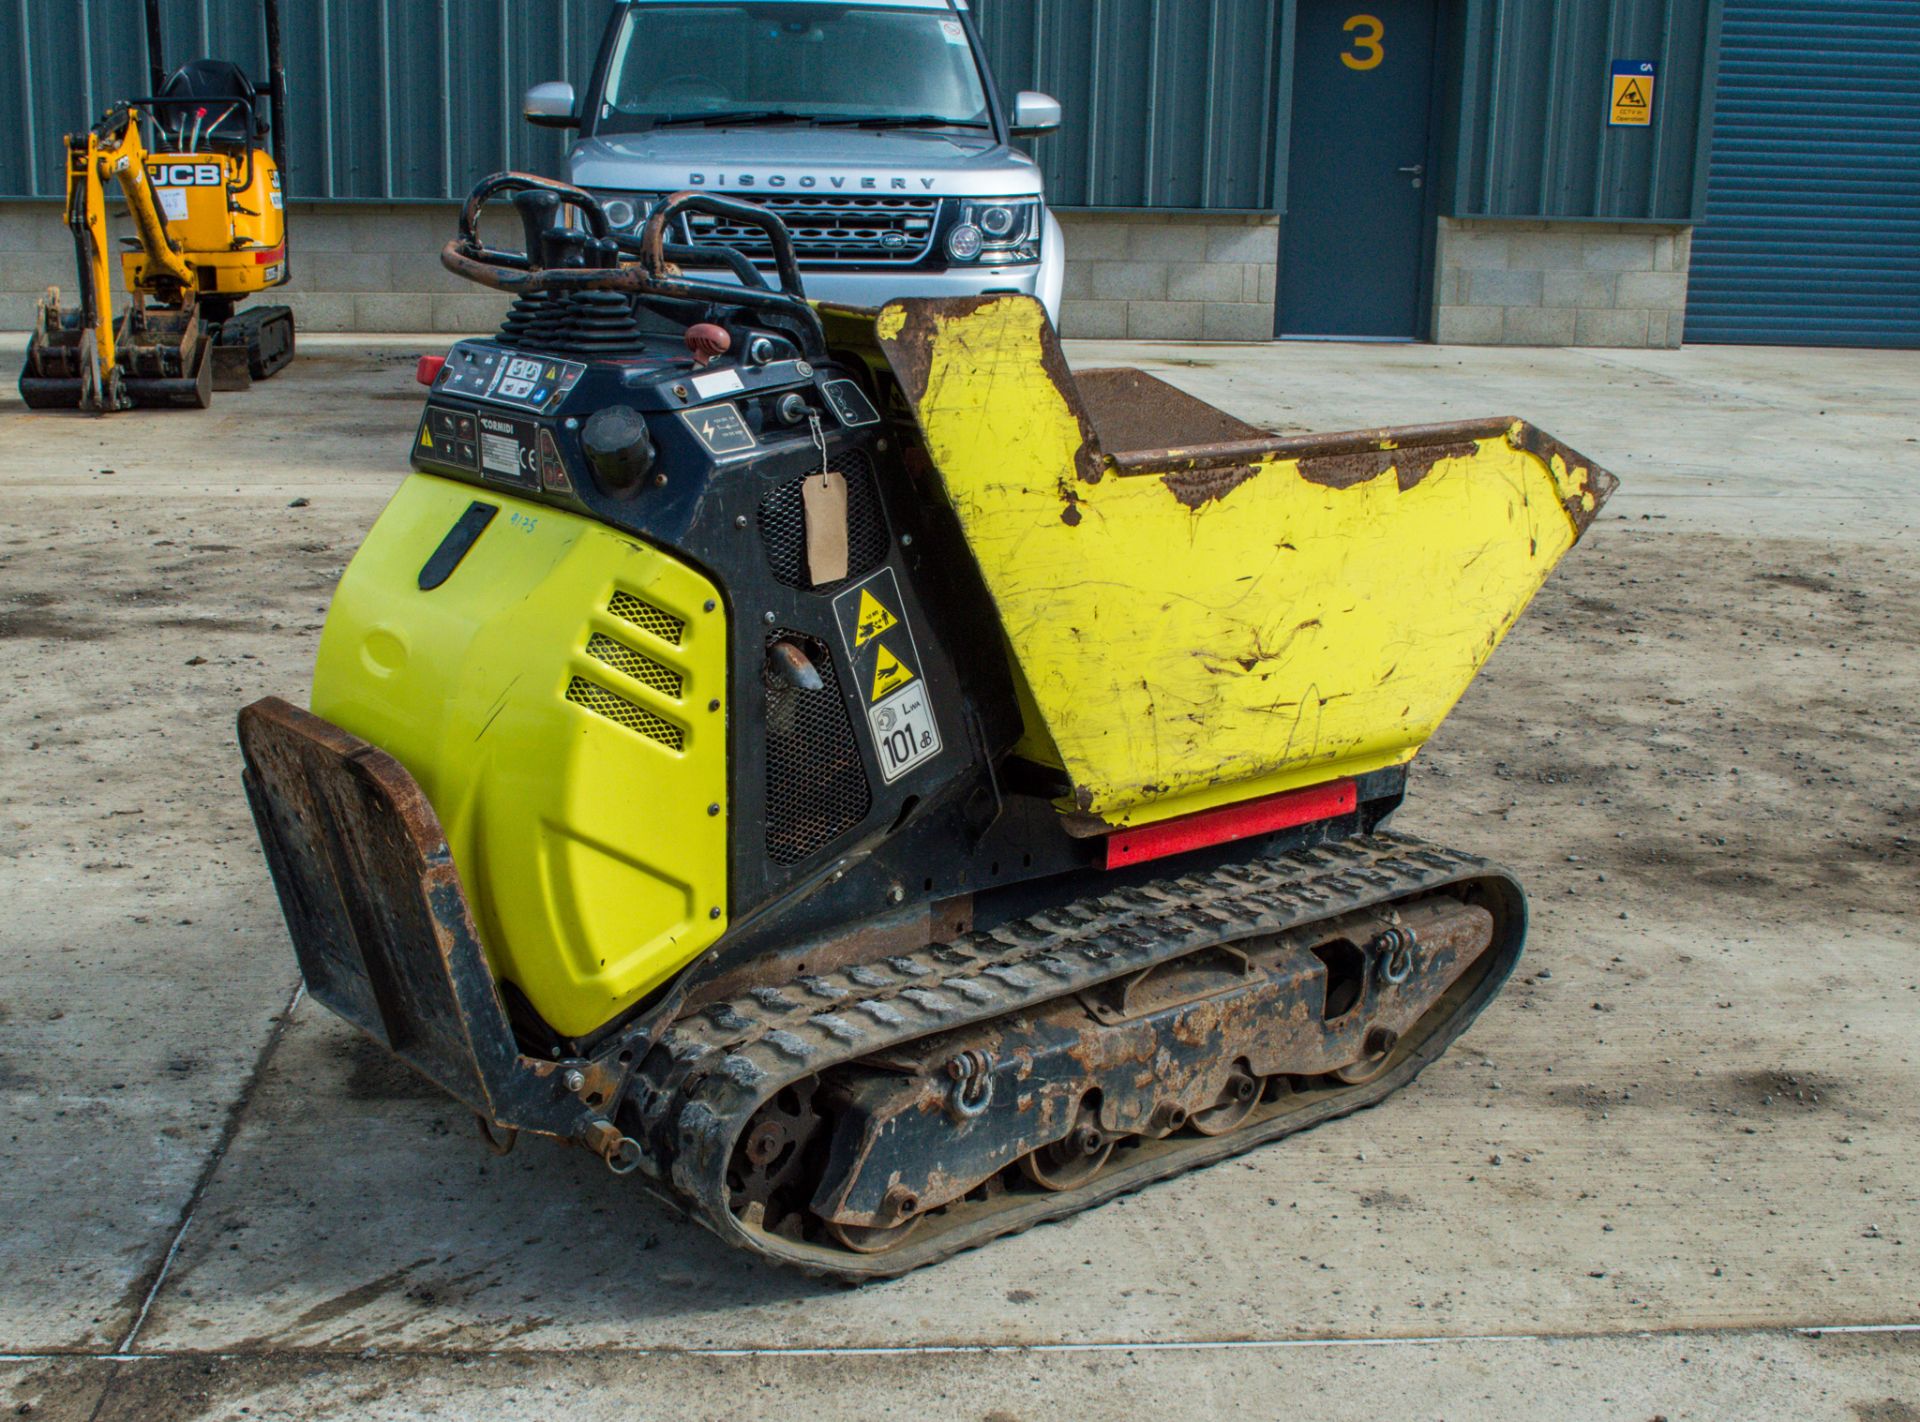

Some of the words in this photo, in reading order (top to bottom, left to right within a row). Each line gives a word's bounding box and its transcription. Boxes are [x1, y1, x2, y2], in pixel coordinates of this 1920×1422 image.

[1340, 14, 1384, 70] 3
[151, 165, 220, 185] JCB
[689, 173, 935, 189] DISCOVERY
[481, 418, 514, 434] CORMIDI
[883, 723, 918, 768] 101
[920, 731, 932, 749] dB
